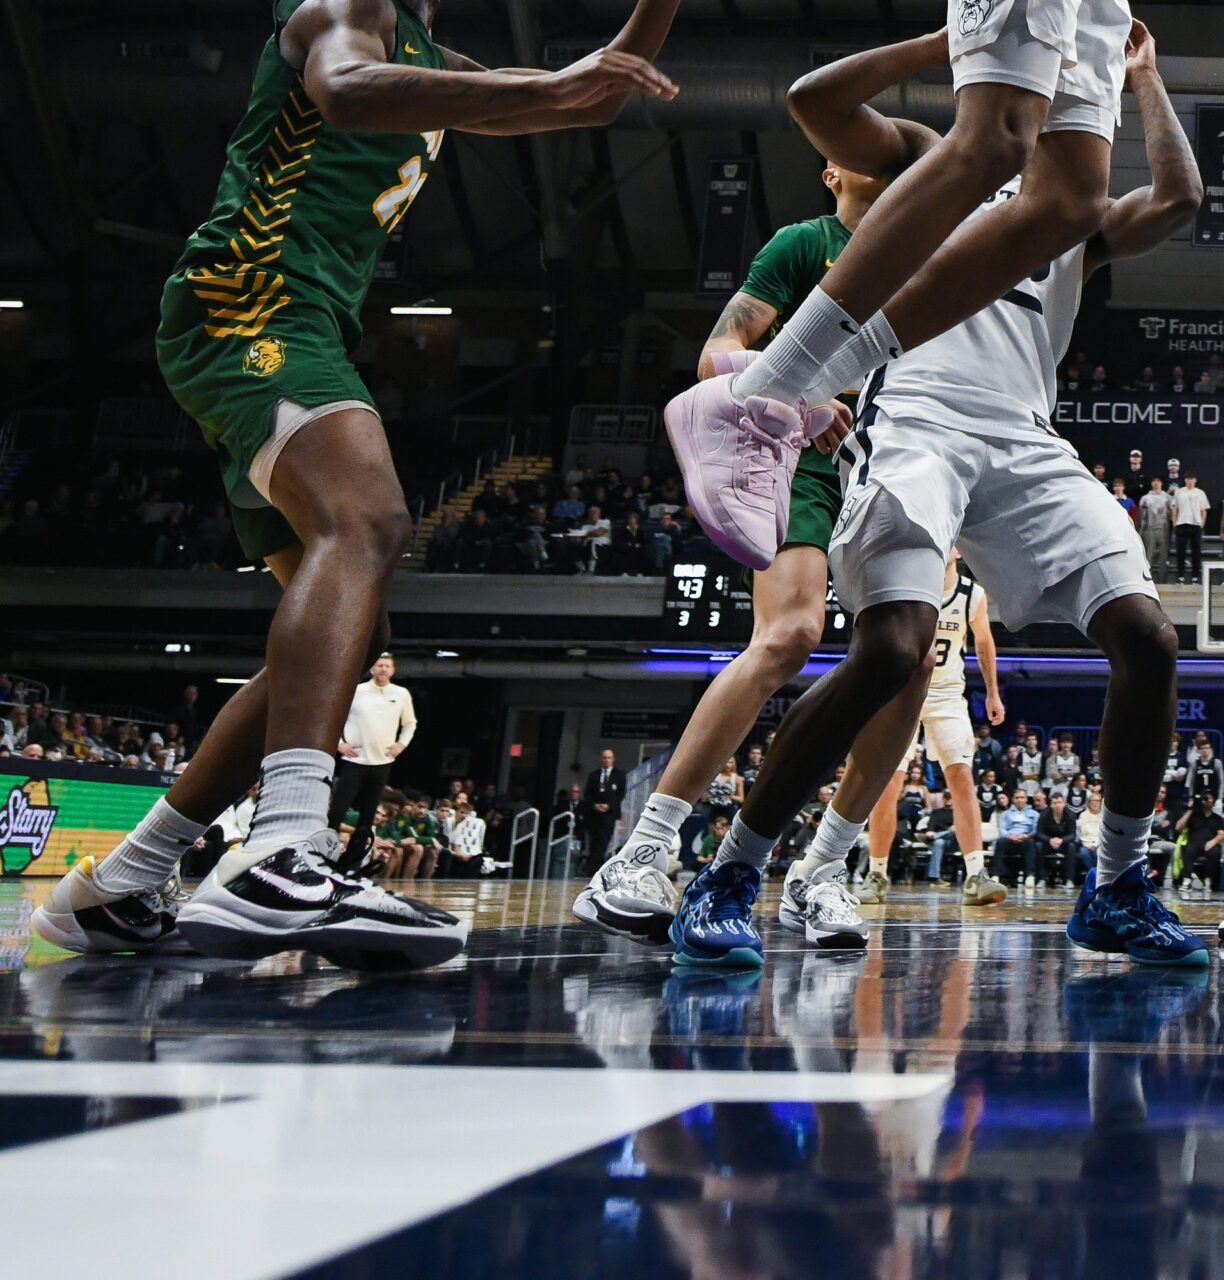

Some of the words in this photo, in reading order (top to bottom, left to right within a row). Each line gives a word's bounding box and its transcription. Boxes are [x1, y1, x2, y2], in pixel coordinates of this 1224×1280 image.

[1169, 339, 1224, 352] HEALTH
[1055, 401, 1172, 424] ELCOME
[1181, 403, 1220, 424] TO
[677, 578, 704, 599] 43
[678, 611, 690, 627] 3
[708, 611, 720, 627] 3
[938, 621, 959, 632] LER
[935, 638, 951, 667] 3
[1176, 699, 1206, 720] ER
[0, 789, 56, 856] Starry
